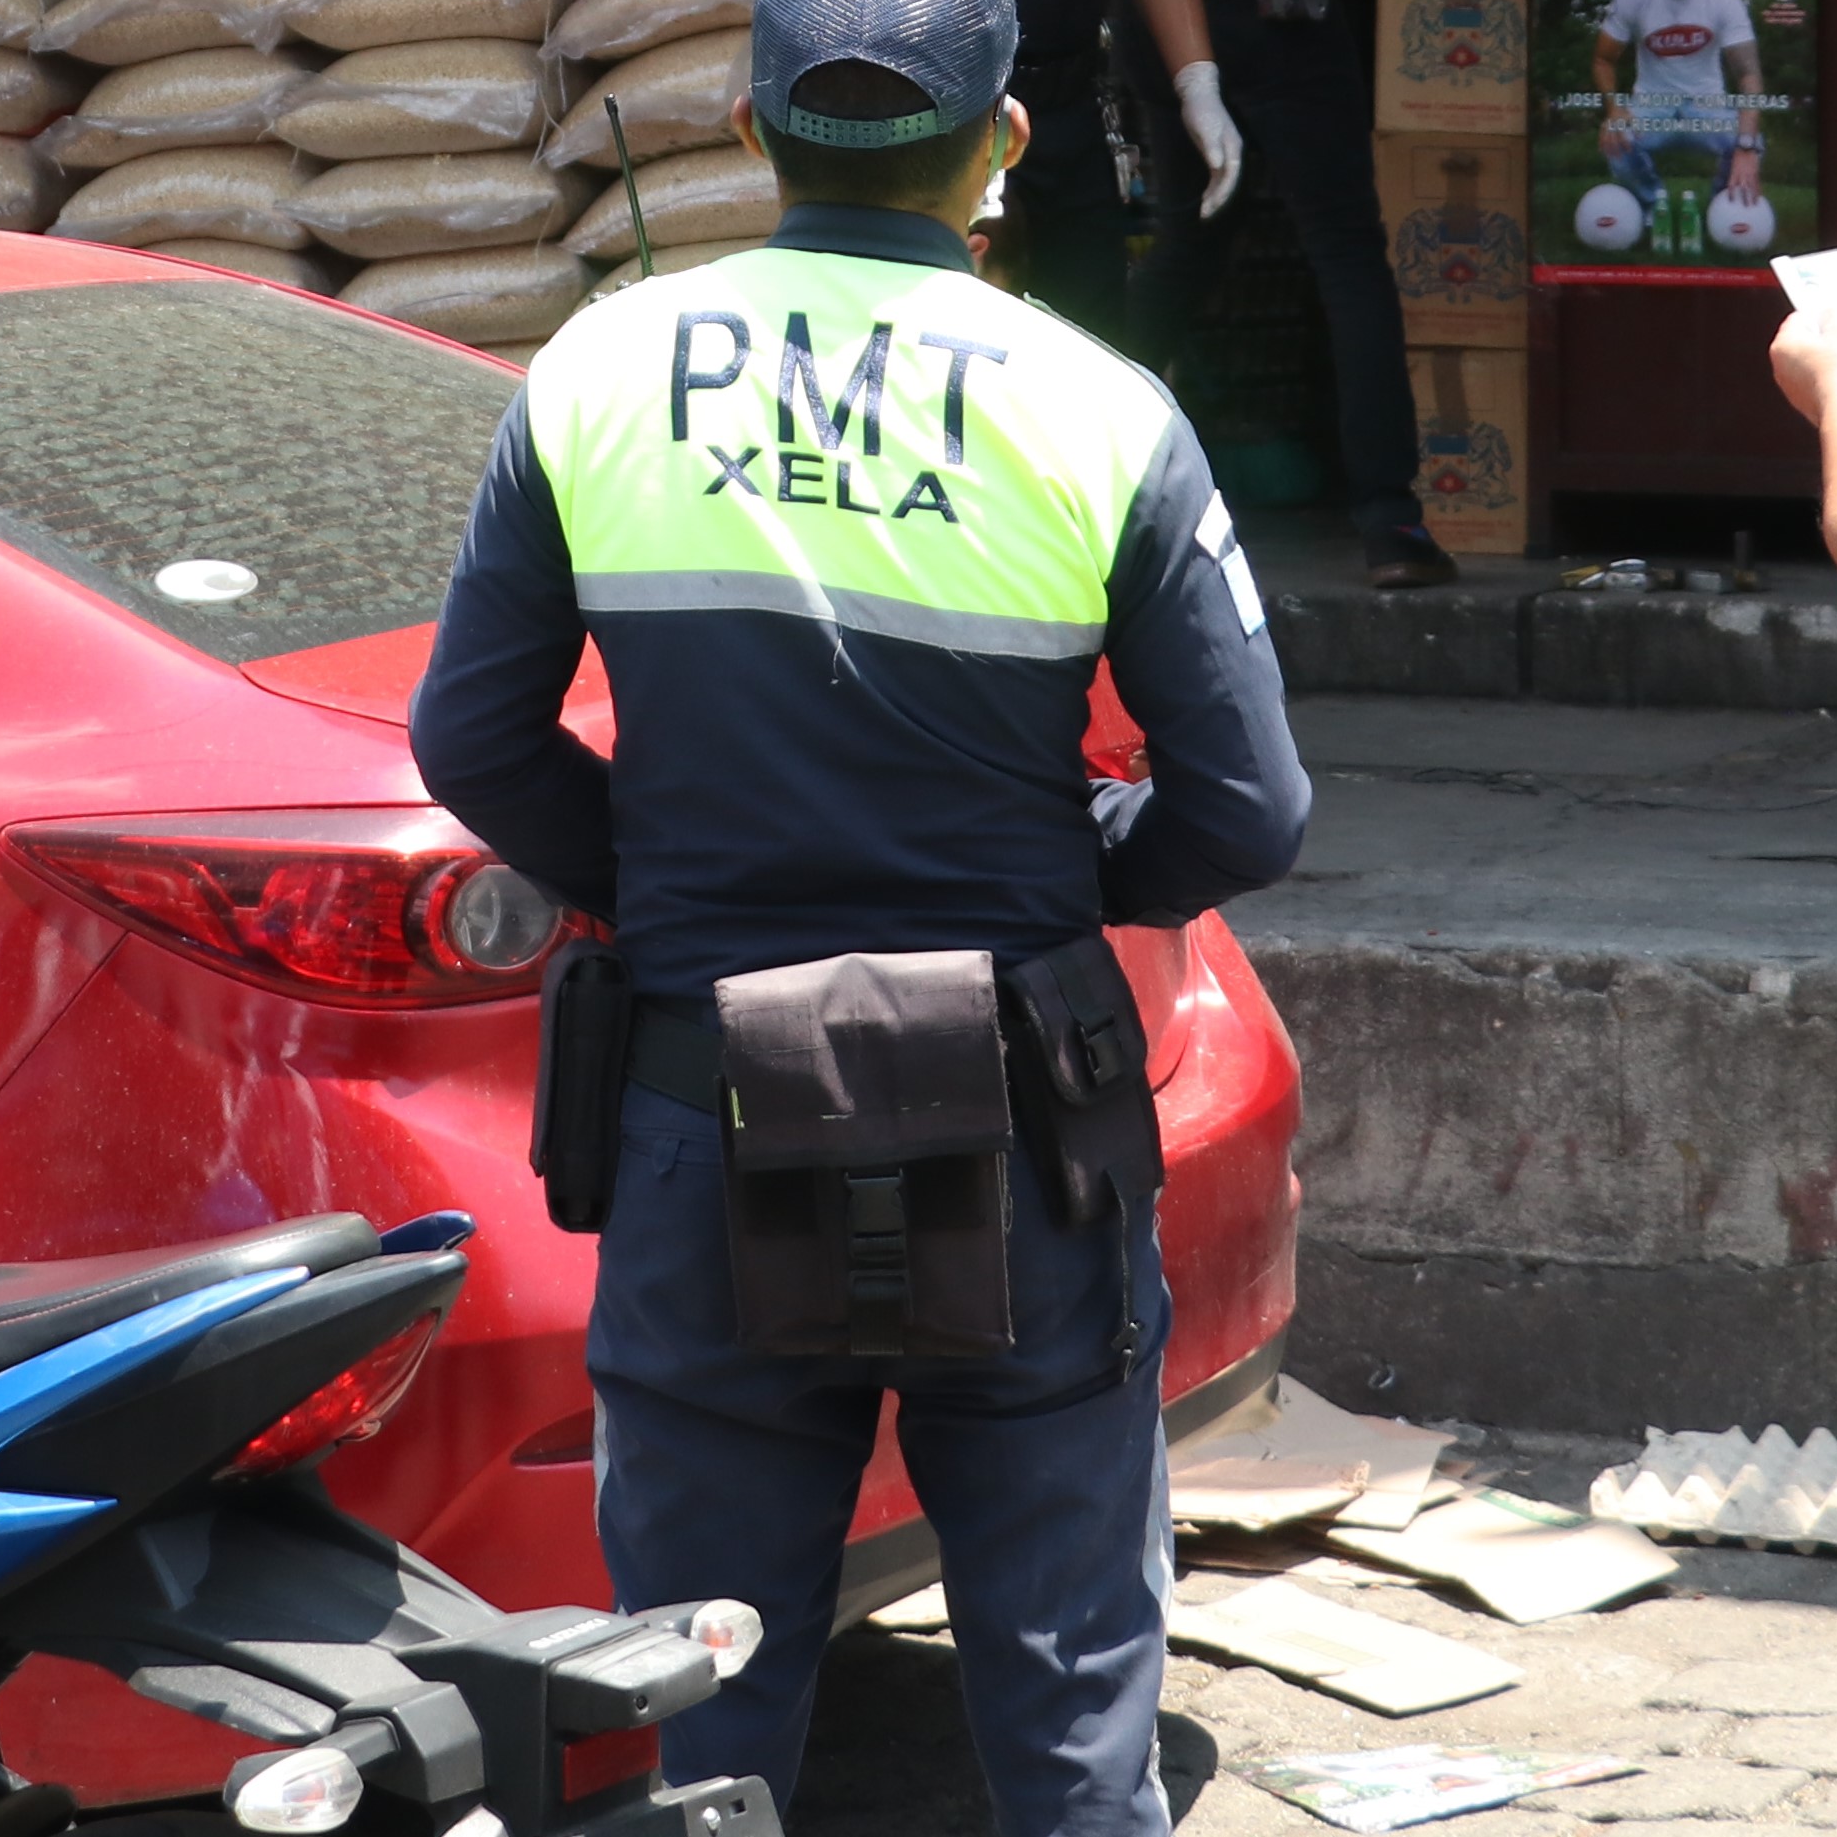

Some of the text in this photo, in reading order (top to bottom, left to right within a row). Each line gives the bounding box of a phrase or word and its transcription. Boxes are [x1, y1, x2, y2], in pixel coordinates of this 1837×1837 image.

[1648, 30, 1708, 50] KULA
[1693, 93, 1790, 109] CONTRERAS
[1606, 119, 1628, 132] LO
[669, 309, 1009, 466] PMT
[703, 443, 962, 525] XELA
[528, 1617, 611, 1650] SUZUKI
